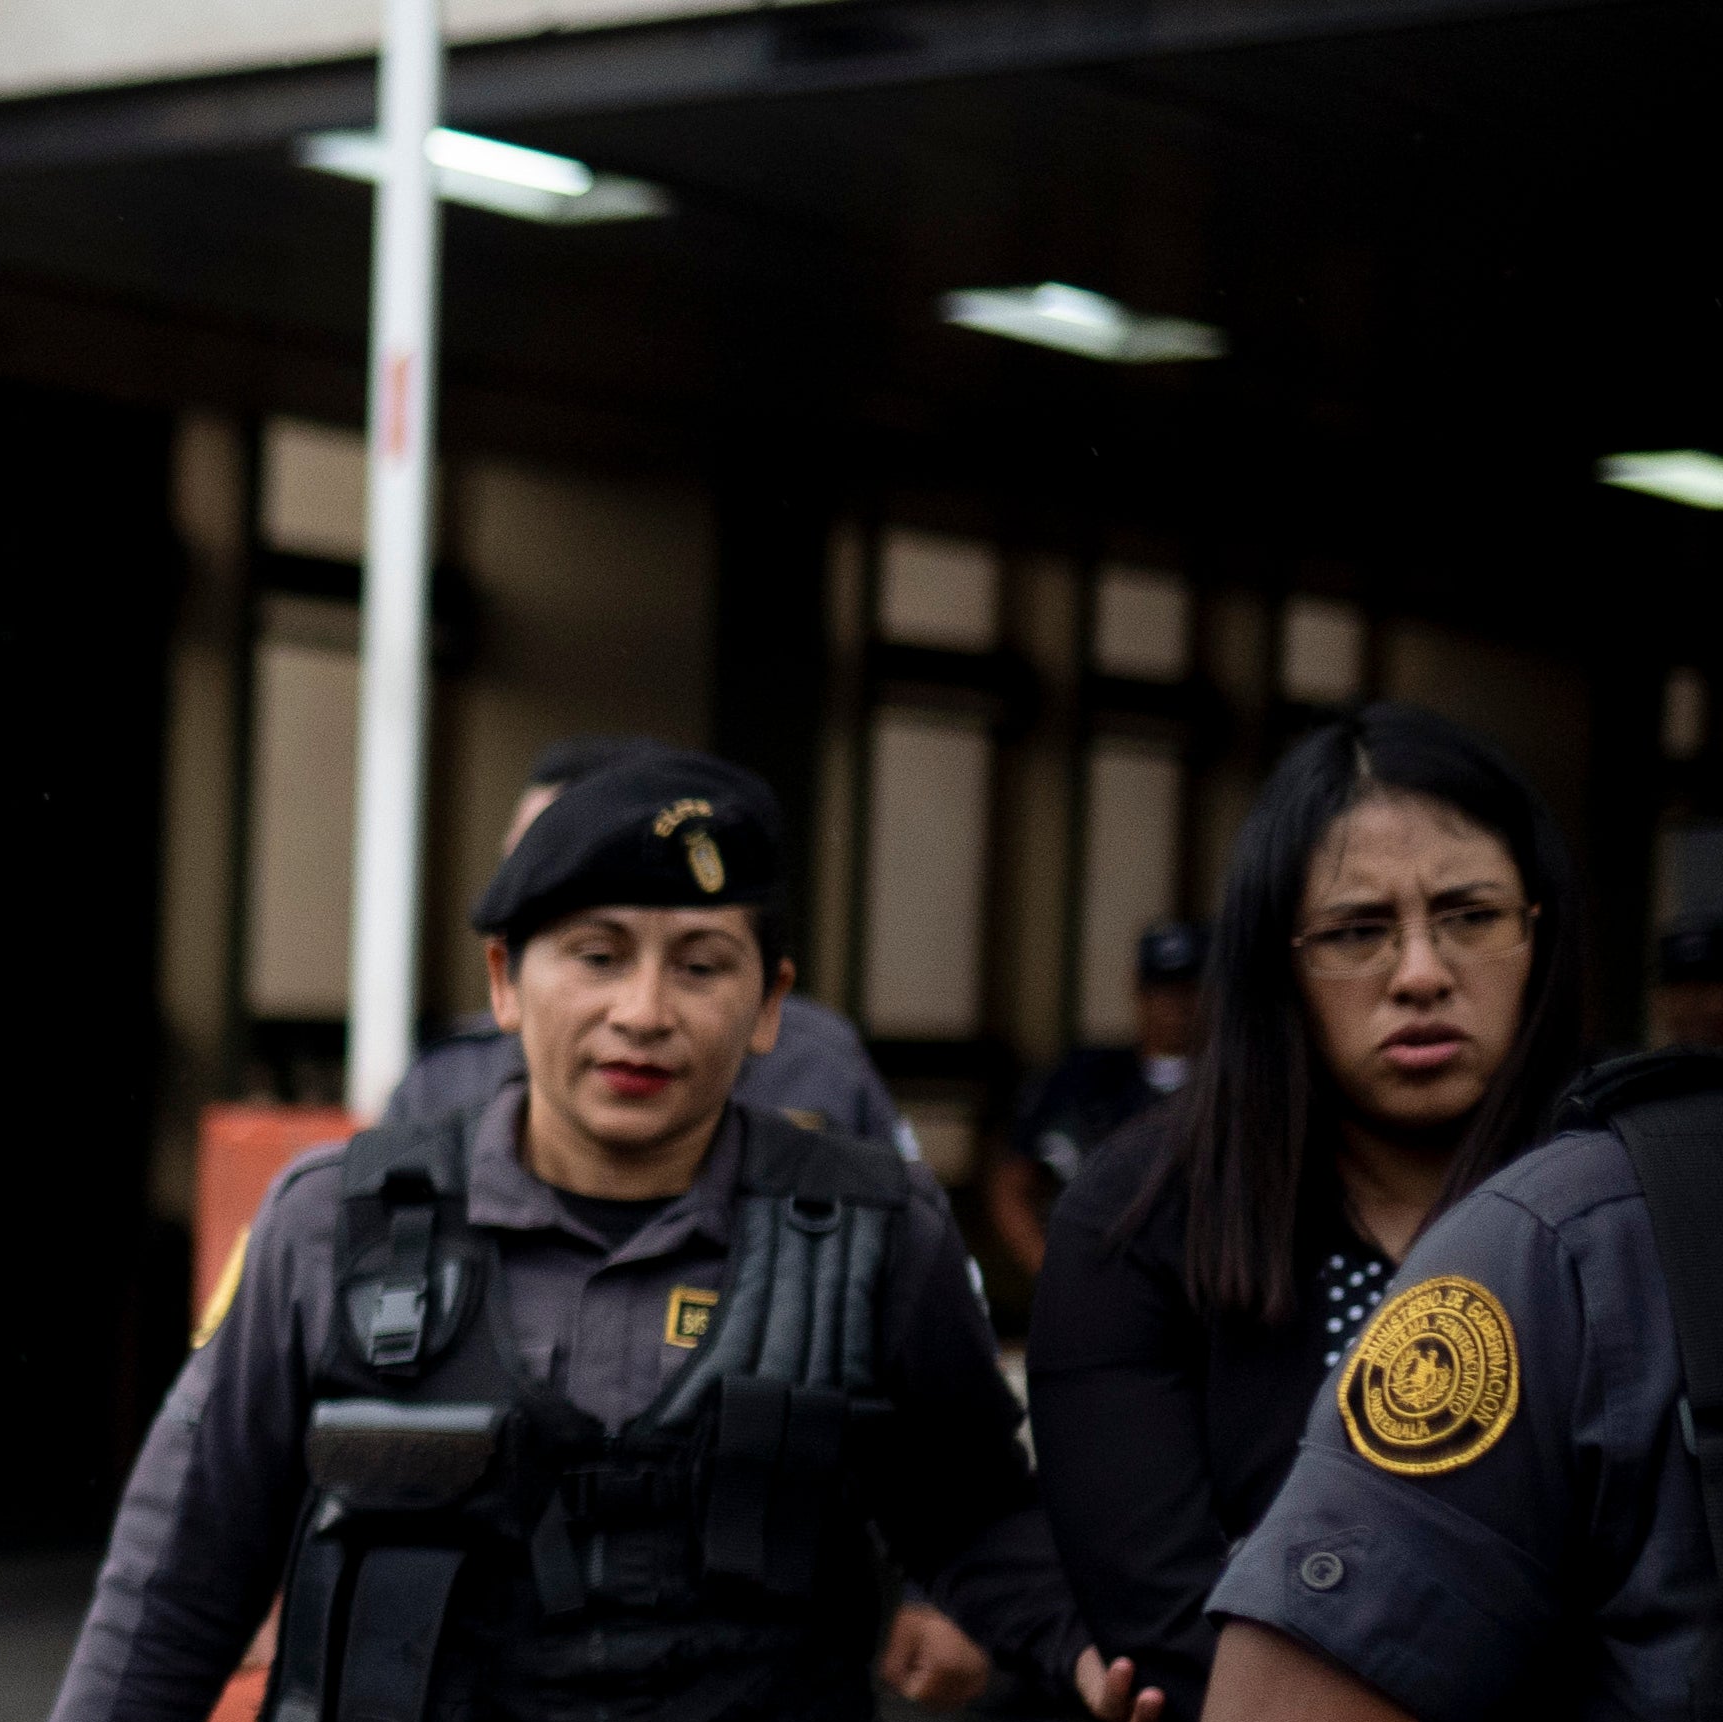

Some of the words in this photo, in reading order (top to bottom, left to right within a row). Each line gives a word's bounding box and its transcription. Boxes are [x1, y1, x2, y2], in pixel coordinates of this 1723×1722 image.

[1362, 1290, 1443, 1361] MINISTERIO
[1446, 1290, 1469, 1310] DE
[1466, 1301, 1508, 1427] GOBERNACION
[1375, 1316, 1429, 1369] SISTEMA
[1435, 1315, 1479, 1415] PENITENCIARIO
[1368, 1387, 1430, 1439] GUATEMALA
